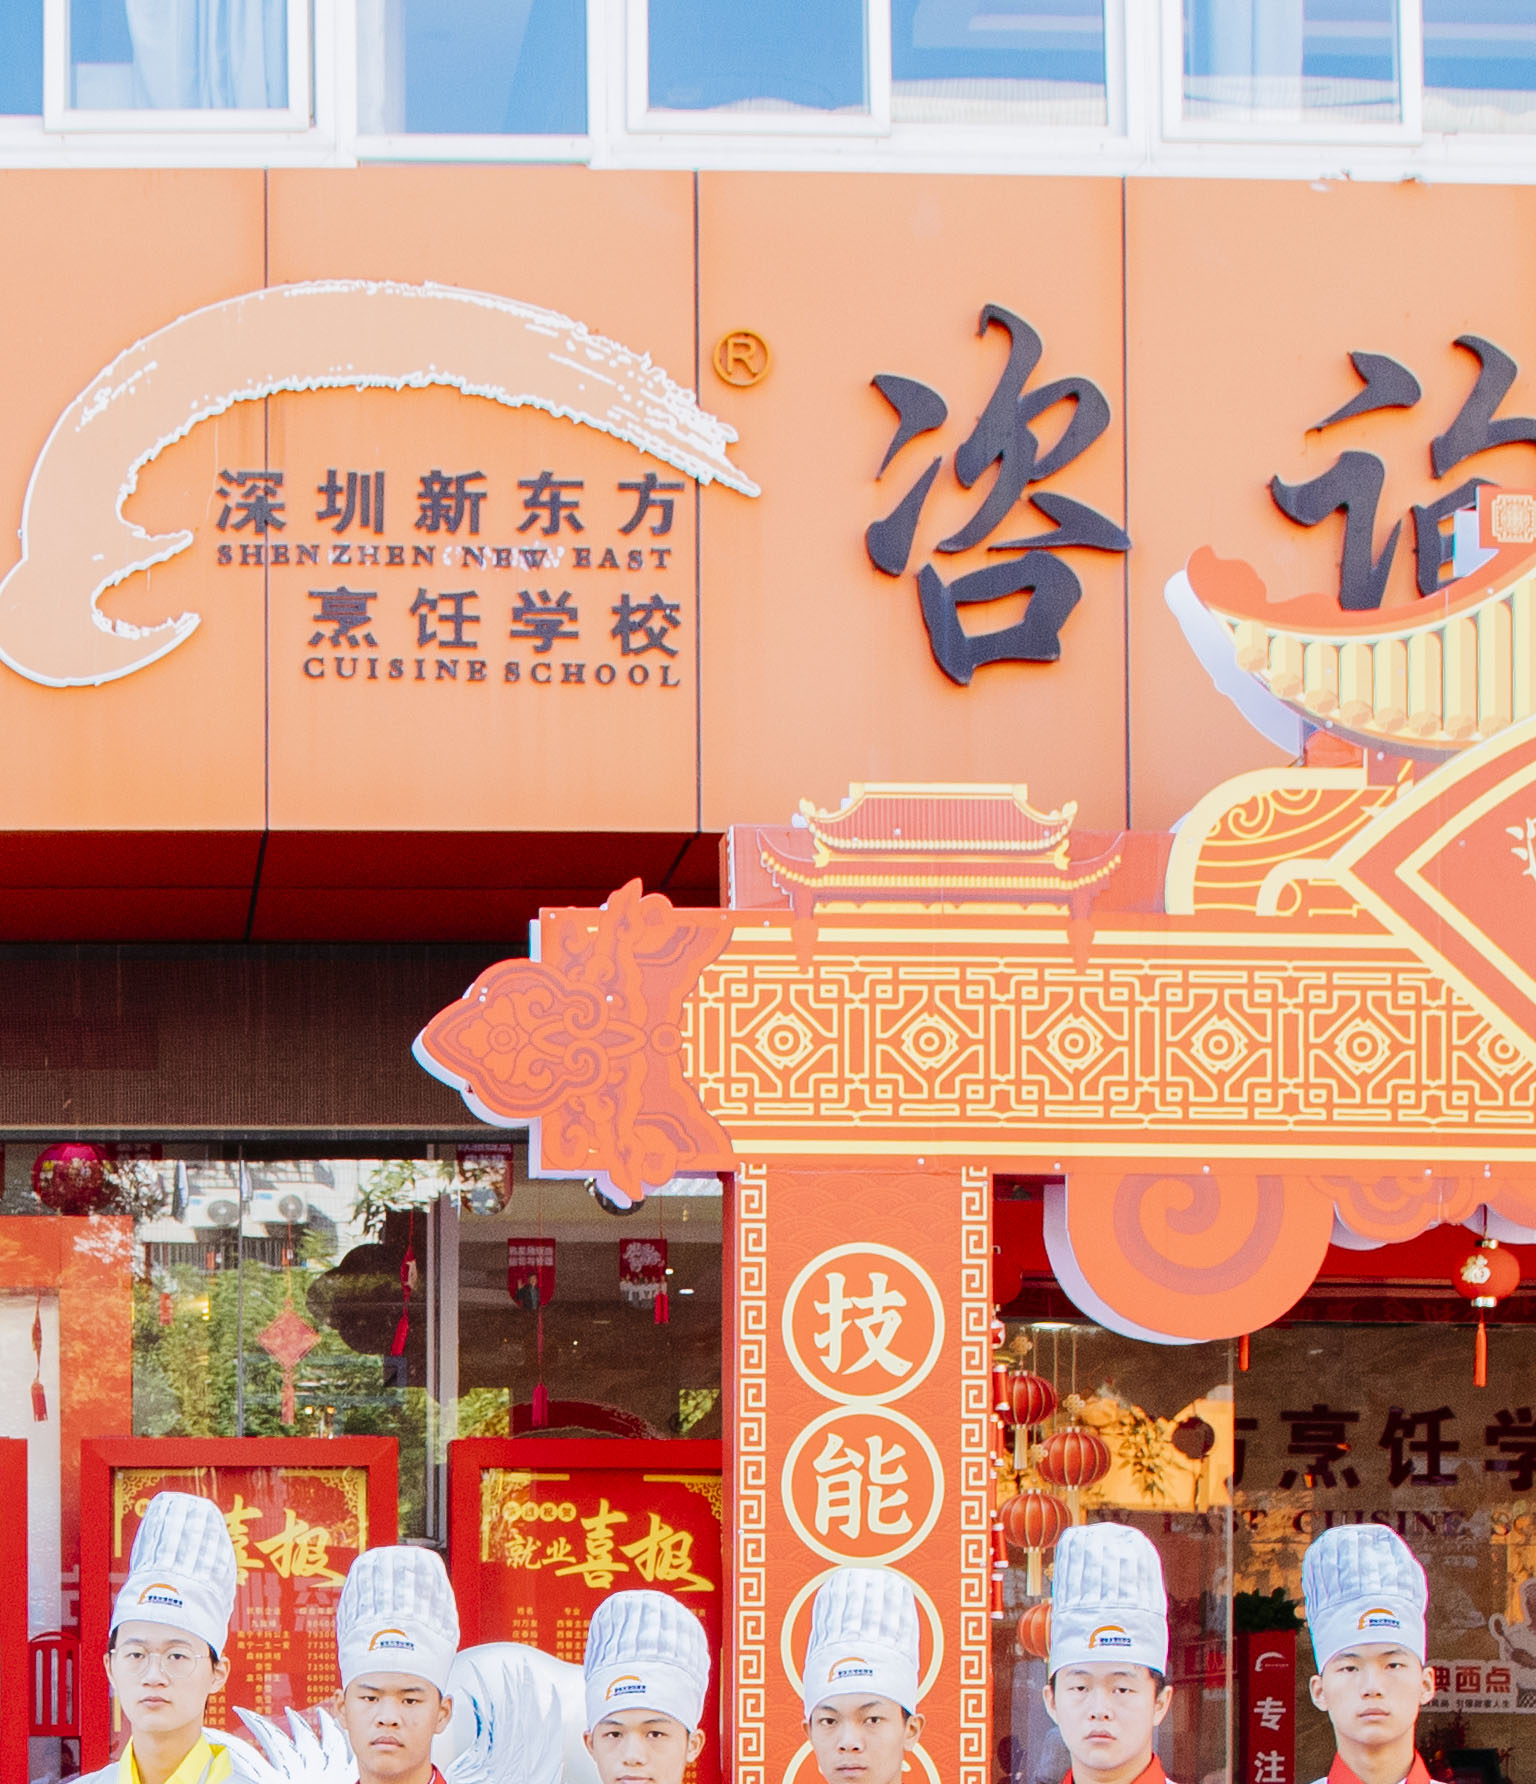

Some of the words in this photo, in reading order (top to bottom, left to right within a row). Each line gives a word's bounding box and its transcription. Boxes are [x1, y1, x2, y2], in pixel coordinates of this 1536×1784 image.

[215, 469, 687, 536] 深圳新东方
[217, 543, 436, 567] SHENZHEN
[461, 545, 559, 570] NEW
[573, 546, 672, 570] EAST
[306, 587, 683, 656] 烹饪学校
[303, 656, 488, 683] CUISINE
[504, 660, 681, 687] SCHOOL
[503, 1497, 716, 1593] 就业喜报
